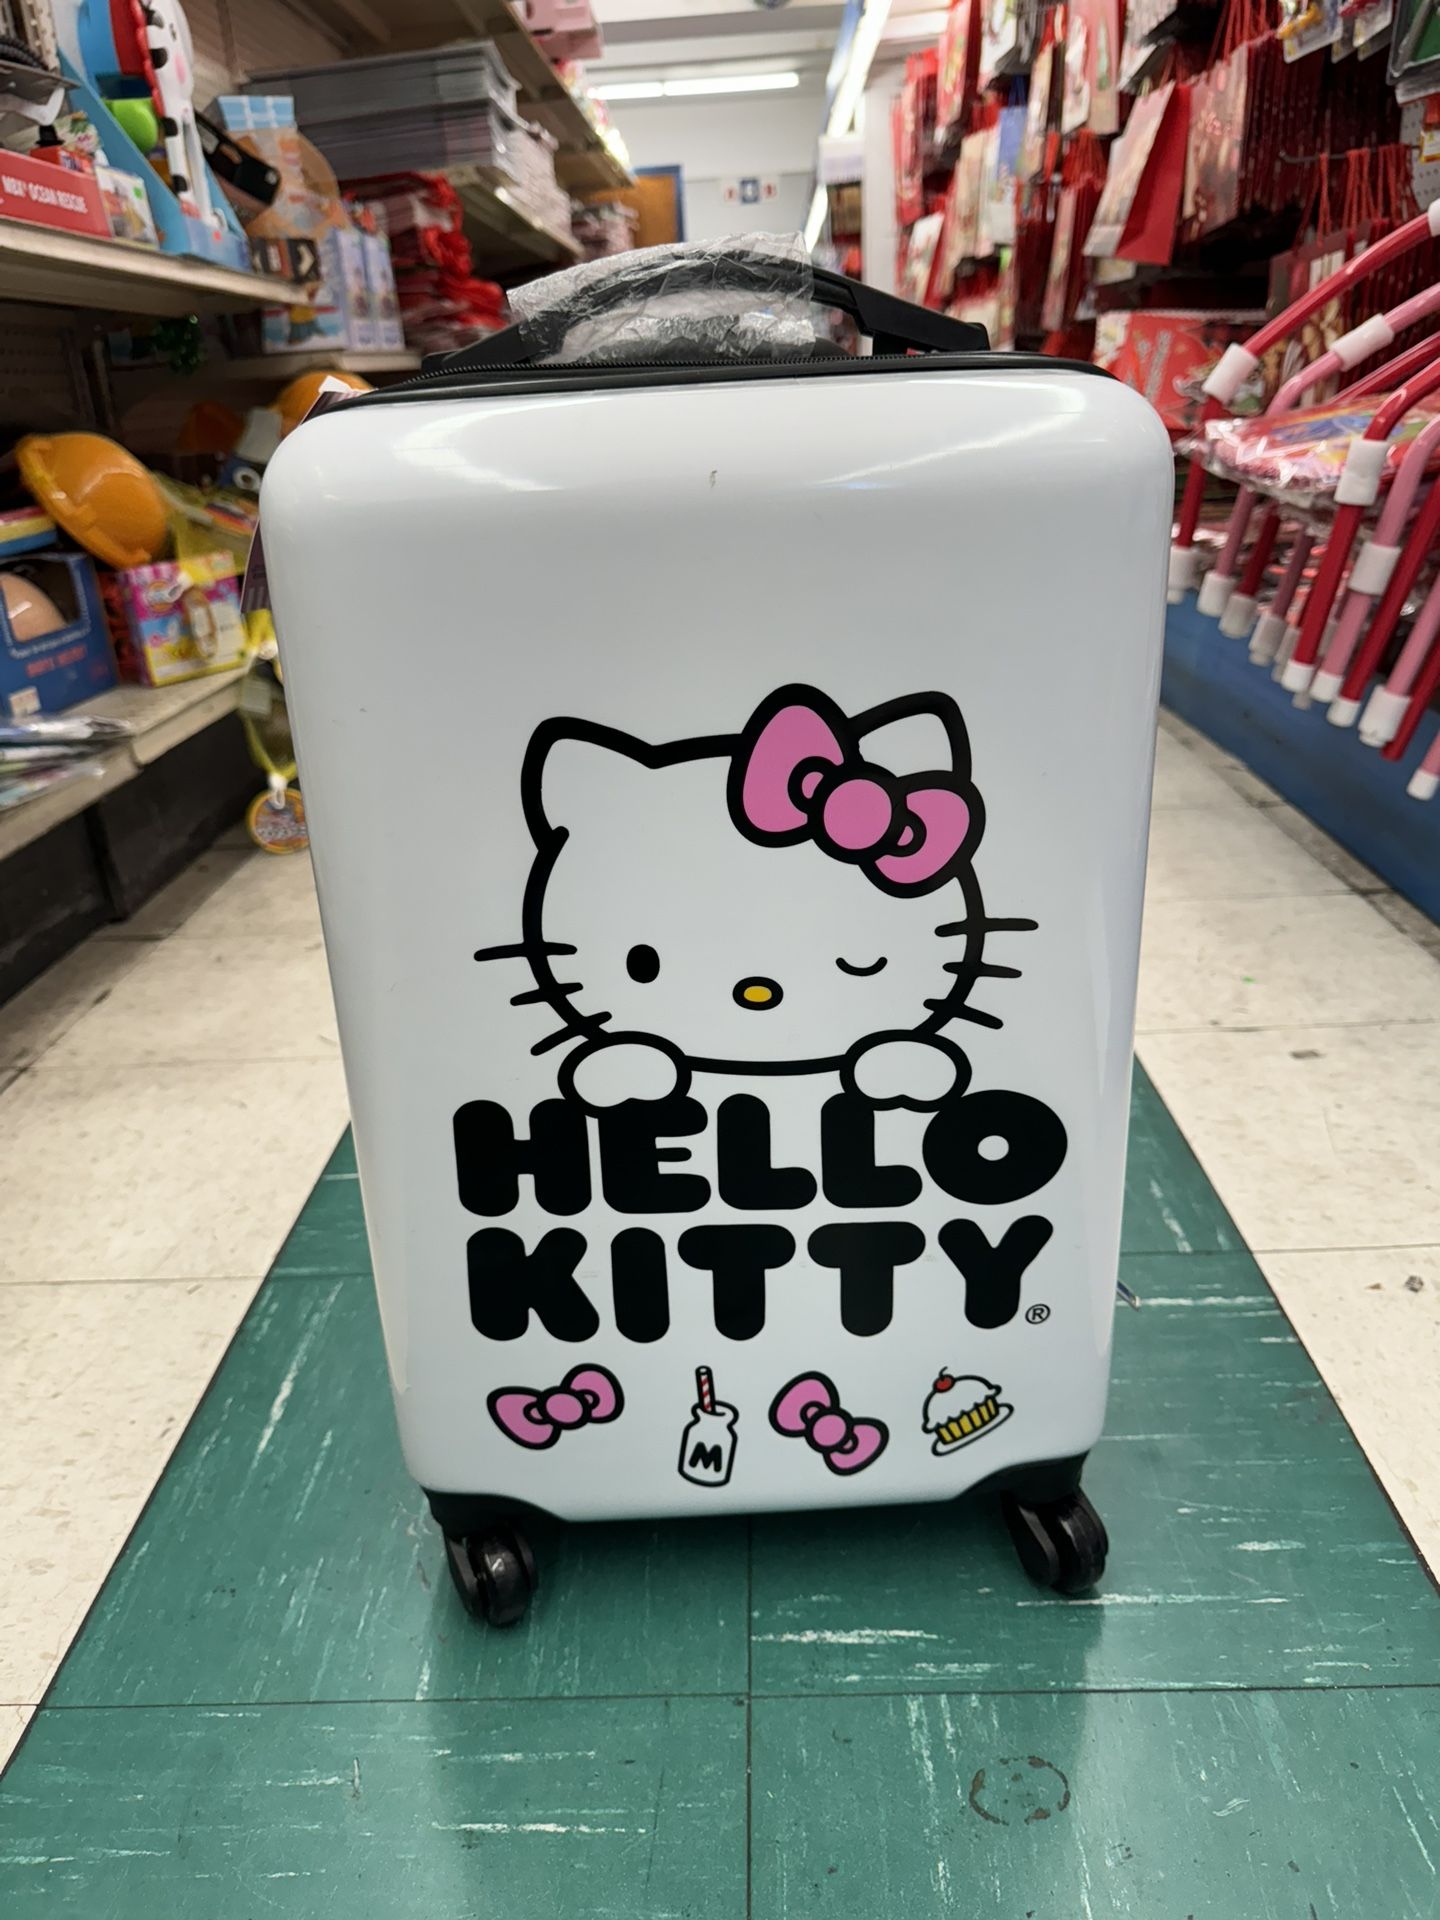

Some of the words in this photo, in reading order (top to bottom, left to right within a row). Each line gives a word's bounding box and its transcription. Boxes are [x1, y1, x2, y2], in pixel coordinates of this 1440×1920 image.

[453, 1089, 1068, 1217] HELLO
[467, 1215, 1053, 1343] KITTY
[689, 1443, 722, 1473] M
